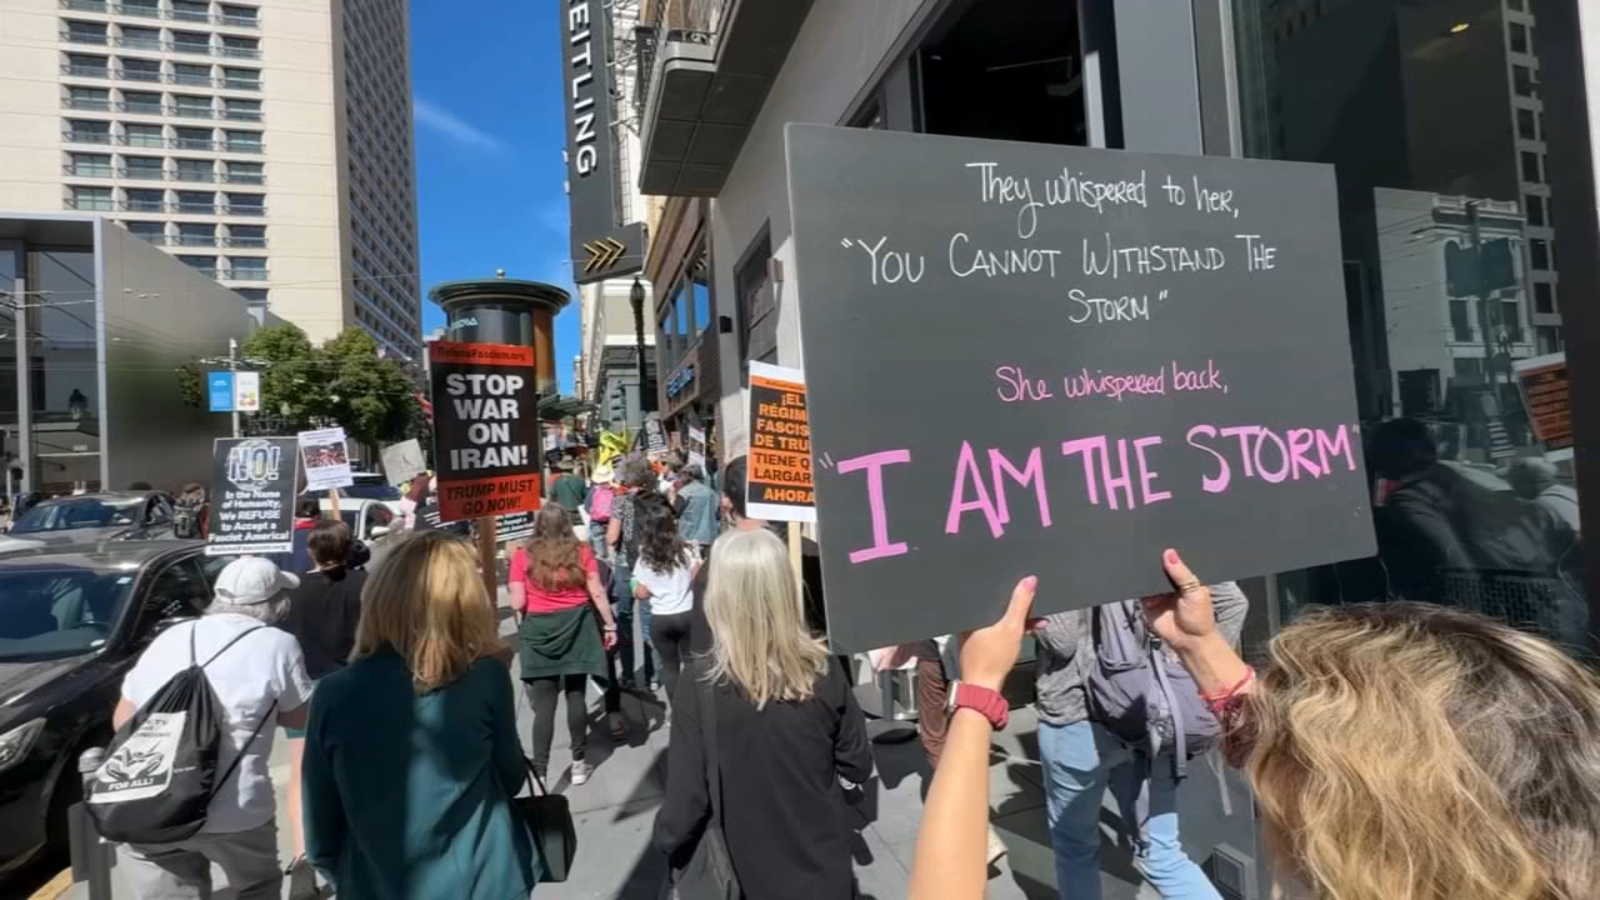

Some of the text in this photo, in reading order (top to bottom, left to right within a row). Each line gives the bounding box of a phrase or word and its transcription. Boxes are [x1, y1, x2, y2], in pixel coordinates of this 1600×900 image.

[966, 161, 1044, 239] They
[1045, 167, 1147, 213] whispered
[1161, 174, 1186, 205] to
[446, 373, 524, 395] STOP
[995, 360, 1229, 402] She whispered back,
[453, 398, 520, 420] WAR
[468, 422, 510, 444] ON
[754, 434, 774, 448] DE
[226, 445, 281, 481] NO!
[450, 445, 528, 470] IRAN!
[754, 452, 796, 468] TIENE
[225, 487, 281, 500] In the Name
[447, 479, 534, 501] TRUMP MUST
[945, 440, 1052, 538] AM
[1062, 435, 1172, 510] THE
[220, 509, 281, 521] We REFUSE
[222, 500, 232, 510] of
[463, 496, 521, 516] GO NOW!
[208, 529, 290, 543] Fascist America!
[221, 522, 232, 532] to
[234, 521, 268, 532] Accept
[108, 781, 129, 791] FOR
